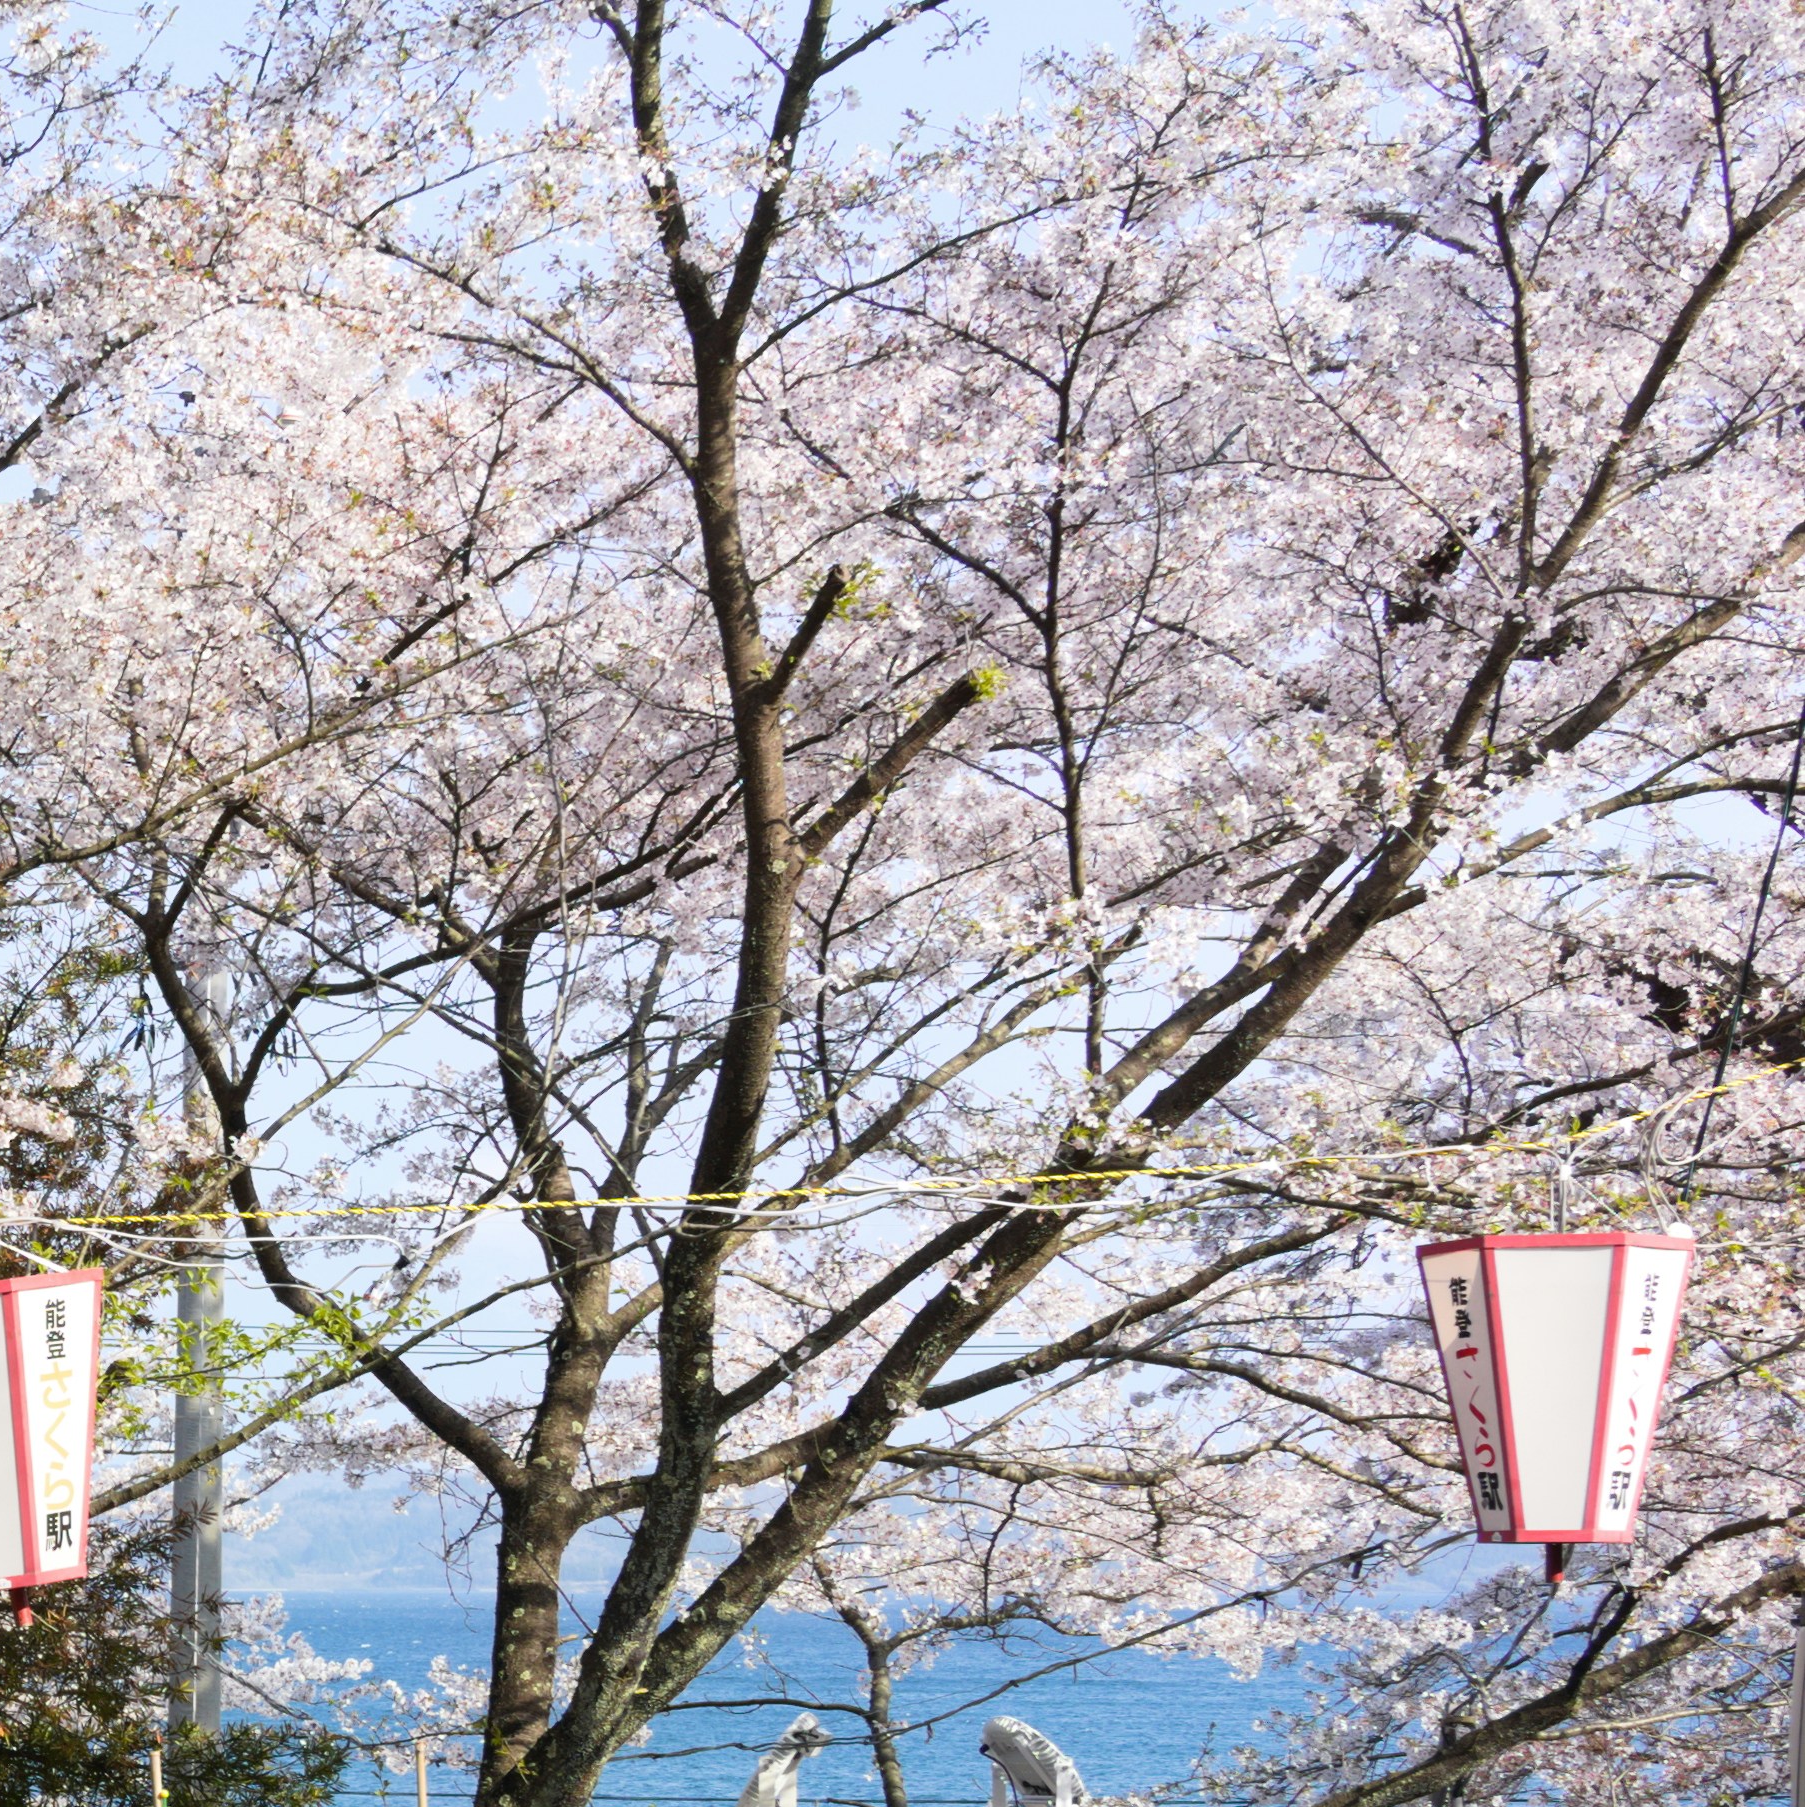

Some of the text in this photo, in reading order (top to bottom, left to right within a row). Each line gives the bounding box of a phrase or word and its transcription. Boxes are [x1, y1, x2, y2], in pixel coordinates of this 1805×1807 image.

[39, 1299, 75, 1552] 能登さくら駅
[1449, 1276, 1504, 1511] 能登さくら駅
[1604, 1273, 1661, 1511] 能登さくら駅
